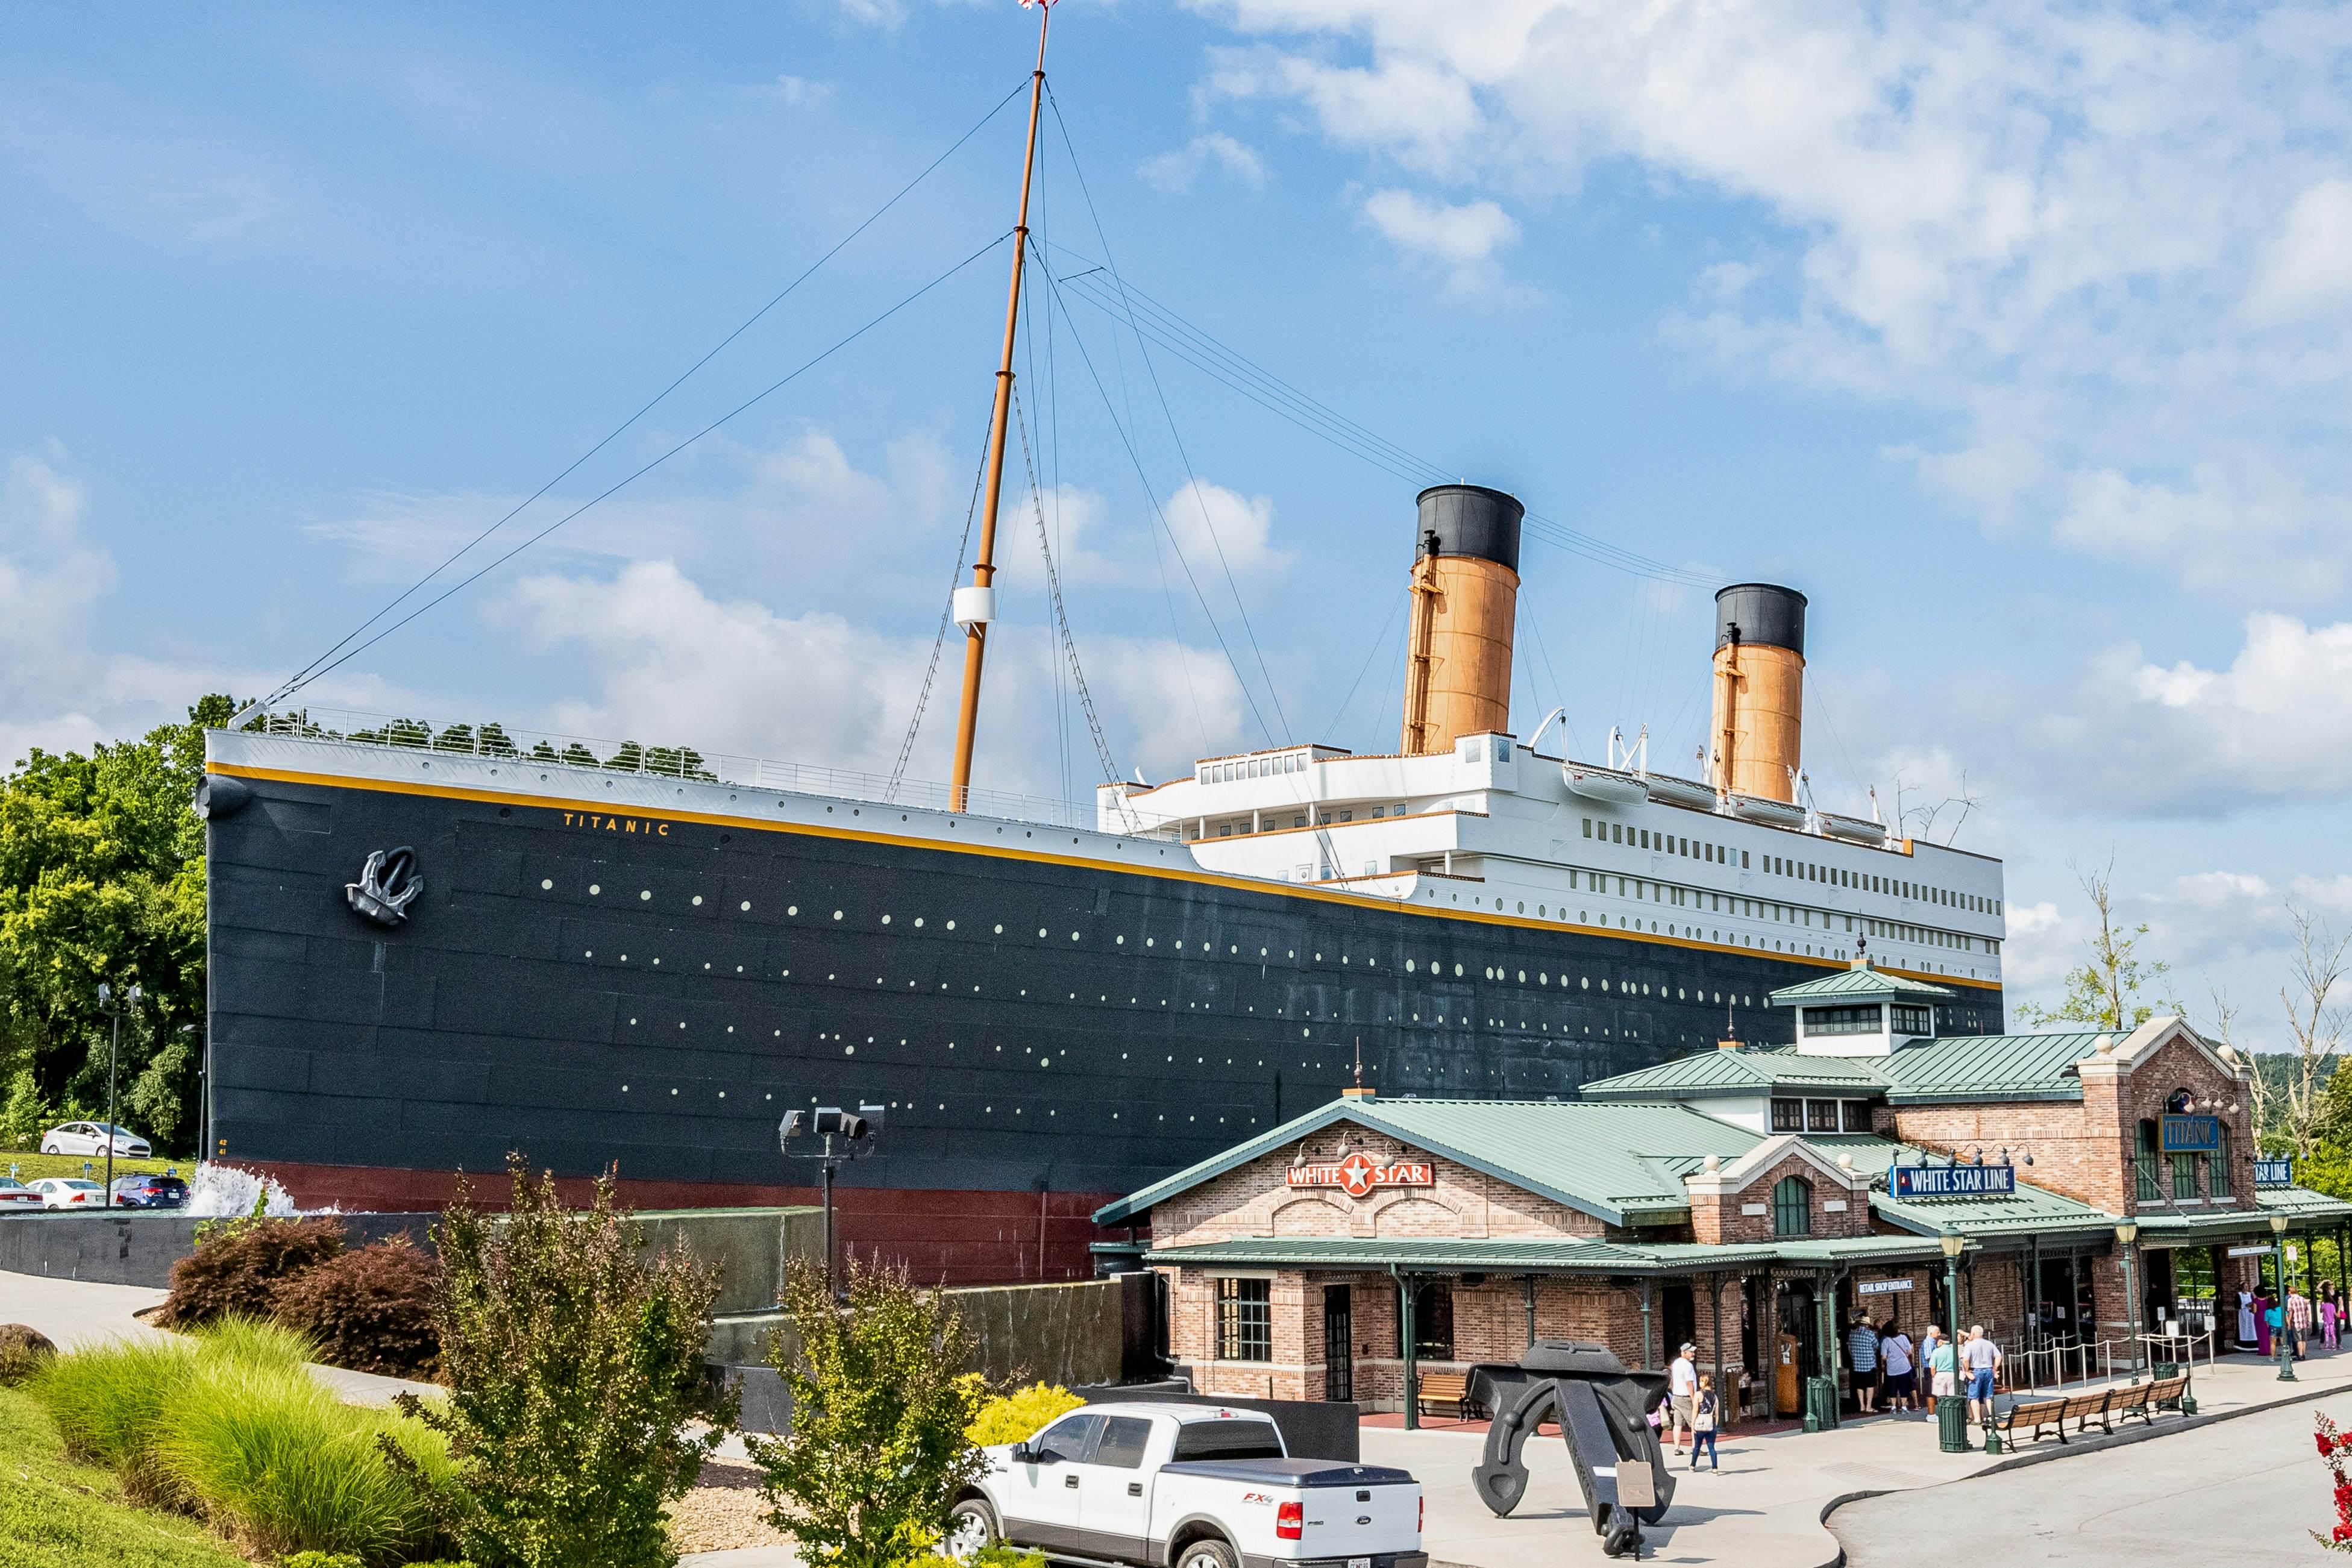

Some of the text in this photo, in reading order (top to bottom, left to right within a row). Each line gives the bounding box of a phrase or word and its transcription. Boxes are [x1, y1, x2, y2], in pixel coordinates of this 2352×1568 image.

[564, 814, 669, 836] TITANIC
[2165, 1120, 2217, 1144] TITANIC
[1290, 1165, 1425, 1184] WHITE STAR
[1910, 1169, 2010, 1192] WHITE STAR LINE
[2254, 1164, 2288, 1181] TAR LINE
[1859, 1279, 1913, 1293] RETAIL SHOP ENTRANCE
[1244, 1493, 1274, 1503] FX4
